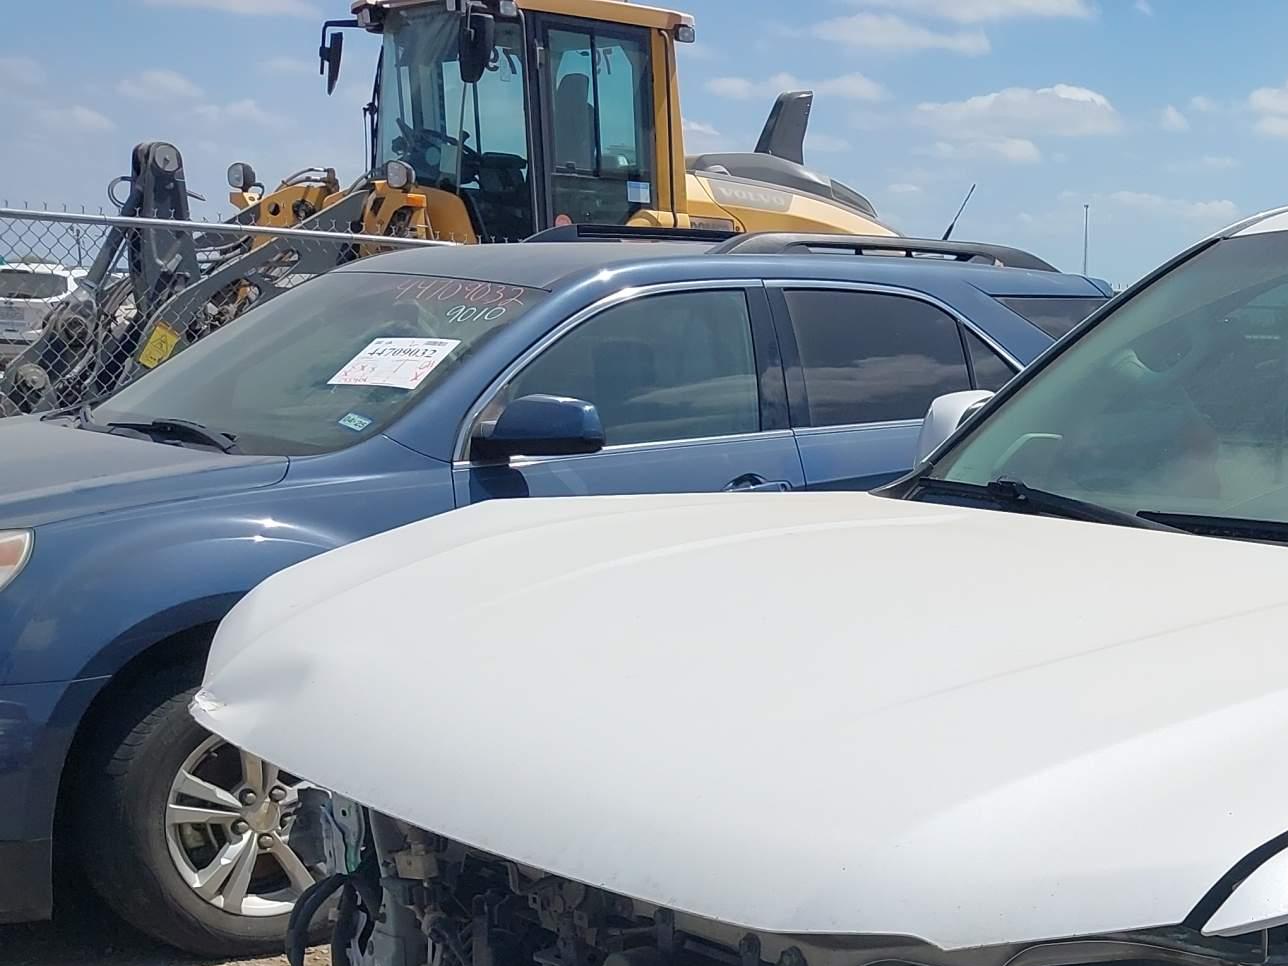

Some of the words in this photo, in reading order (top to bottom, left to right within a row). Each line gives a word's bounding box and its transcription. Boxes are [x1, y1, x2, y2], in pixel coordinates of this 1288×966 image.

[718, 187, 786, 207] VOLVO
[446, 305, 506, 323] 9010
[367, 347, 437, 359] 44709032
